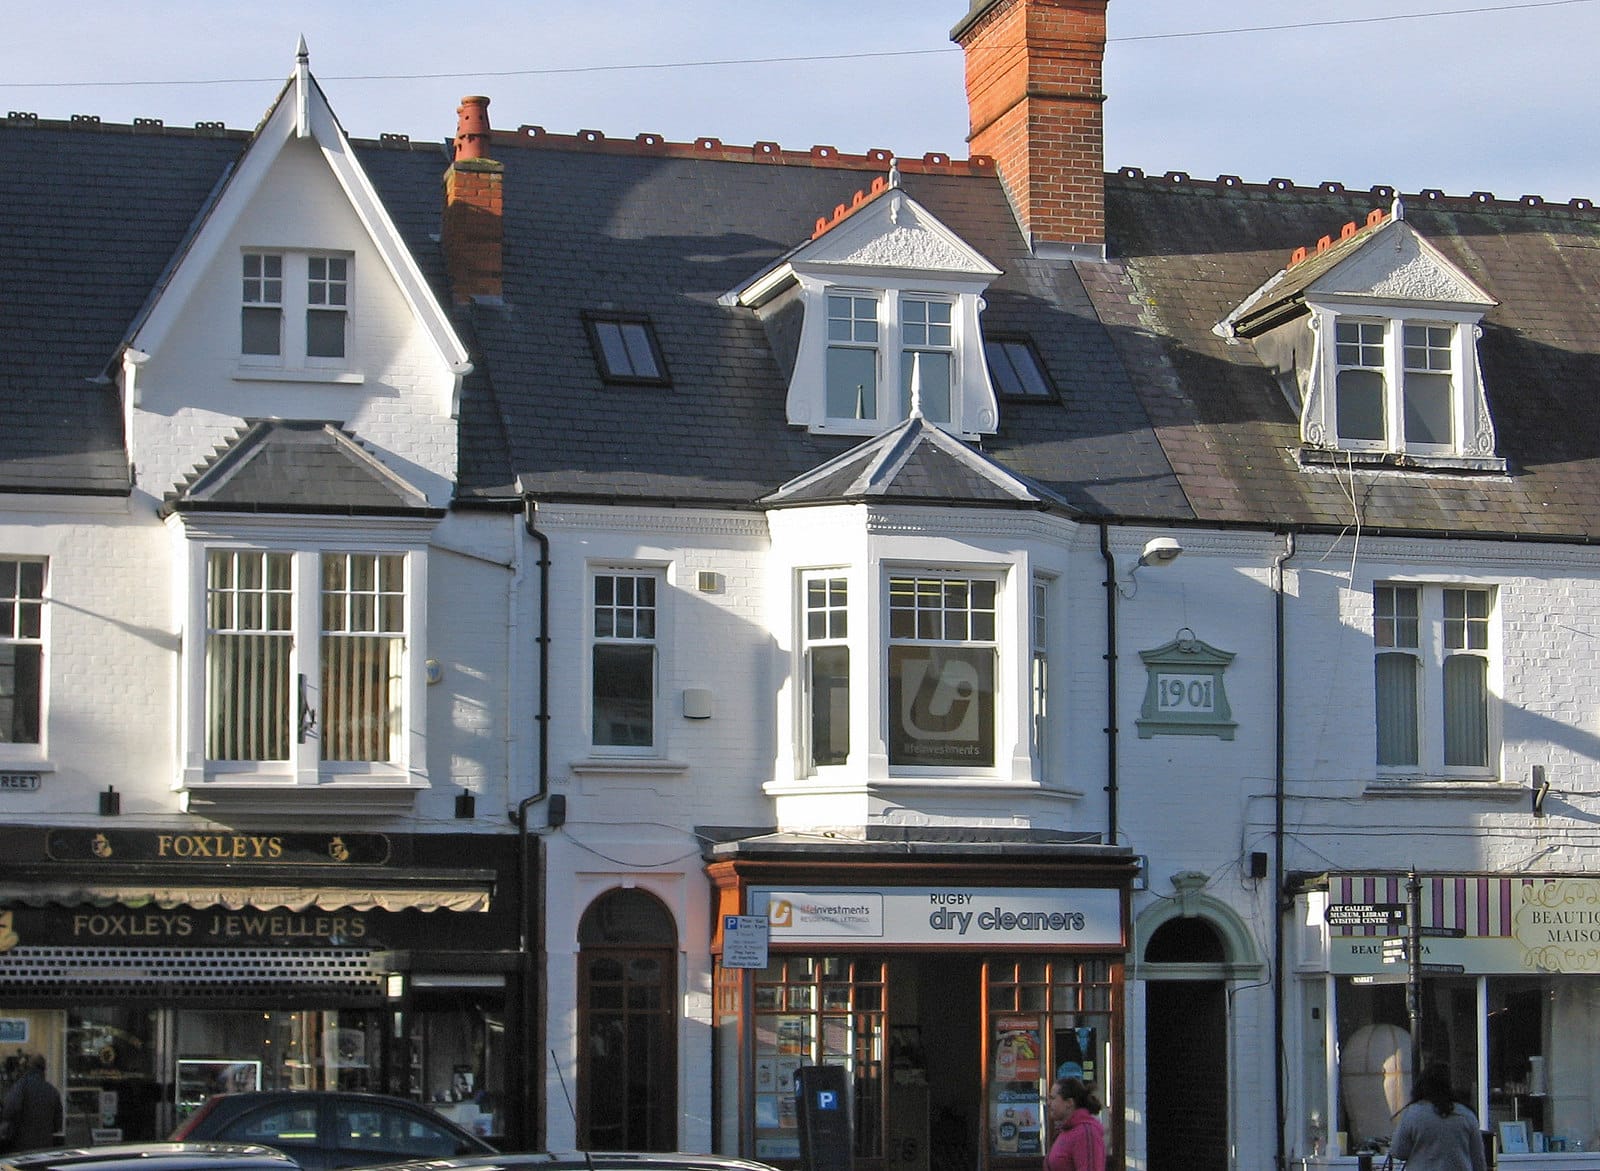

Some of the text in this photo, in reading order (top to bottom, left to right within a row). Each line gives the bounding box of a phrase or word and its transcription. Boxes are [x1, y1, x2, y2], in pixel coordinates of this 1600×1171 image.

[1160, 680, 1213, 707] 1901
[158, 835, 282, 857] FOXLEYS
[930, 893, 973, 904] RUGBY
[73, 915, 366, 938] FOXLEYS JEWELLERS
[727, 918, 737, 929] P
[930, 906, 1085, 935] dry cleaners
[1351, 944, 1381, 955] BEAU
[820, 1092, 833, 1108] P
